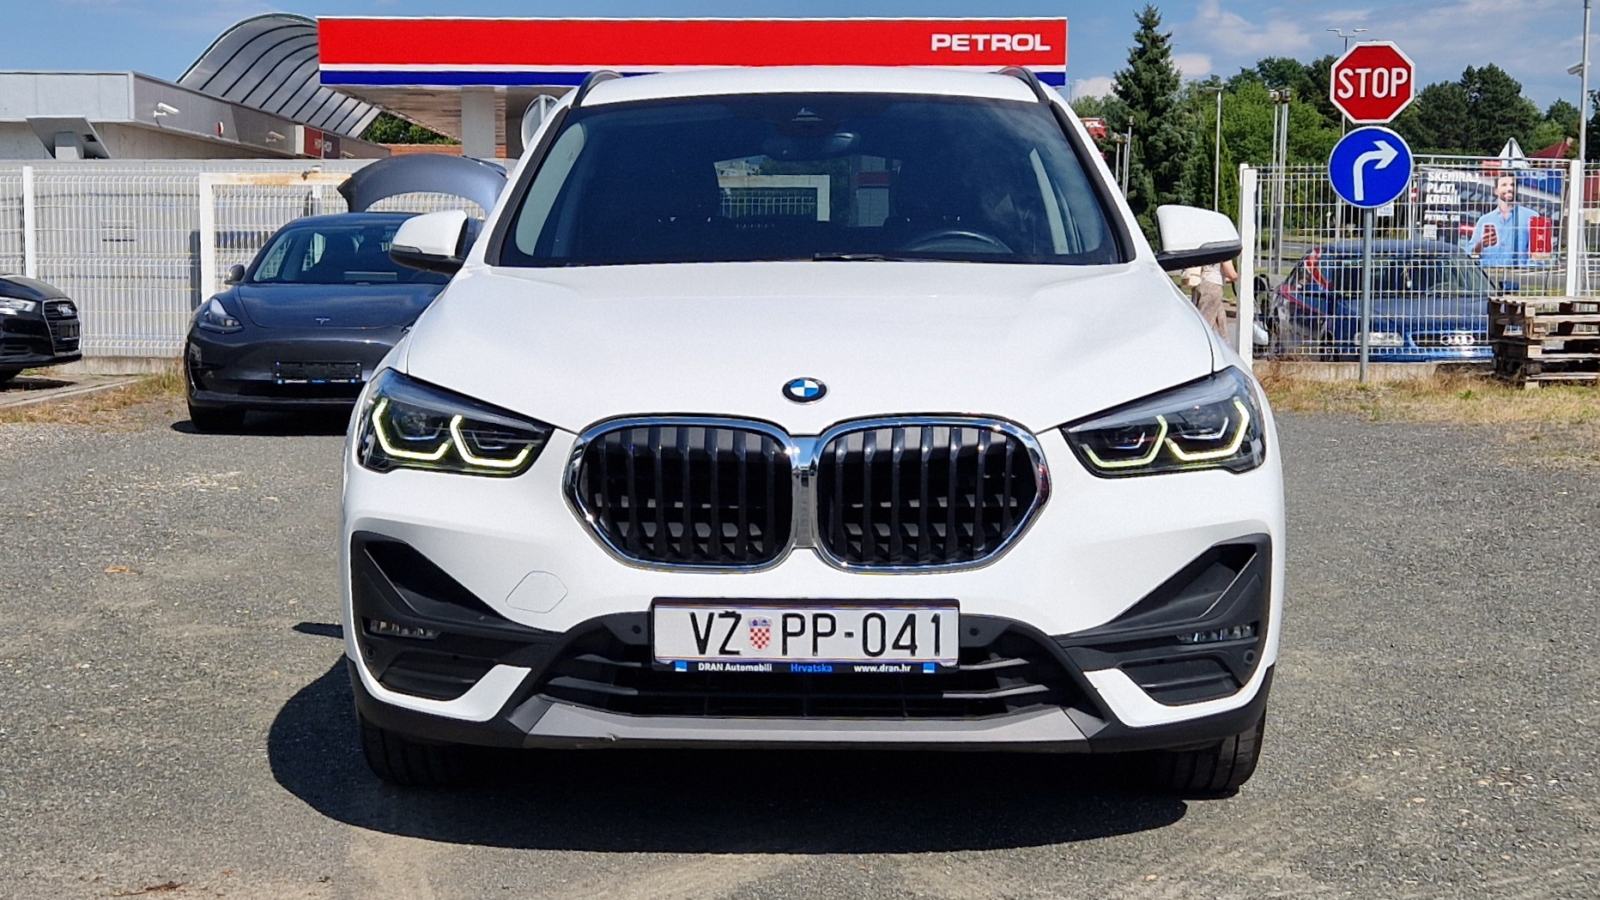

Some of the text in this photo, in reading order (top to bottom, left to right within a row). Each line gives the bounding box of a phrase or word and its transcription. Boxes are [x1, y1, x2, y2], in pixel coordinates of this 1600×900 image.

[931, 33, 1051, 52] PETROL
[1337, 67, 1409, 99] STOP
[690, 610, 942, 657] VŽ PP-041
[698, 662, 912, 673] DRAN Automobili Hrvatska www.dran.hr
